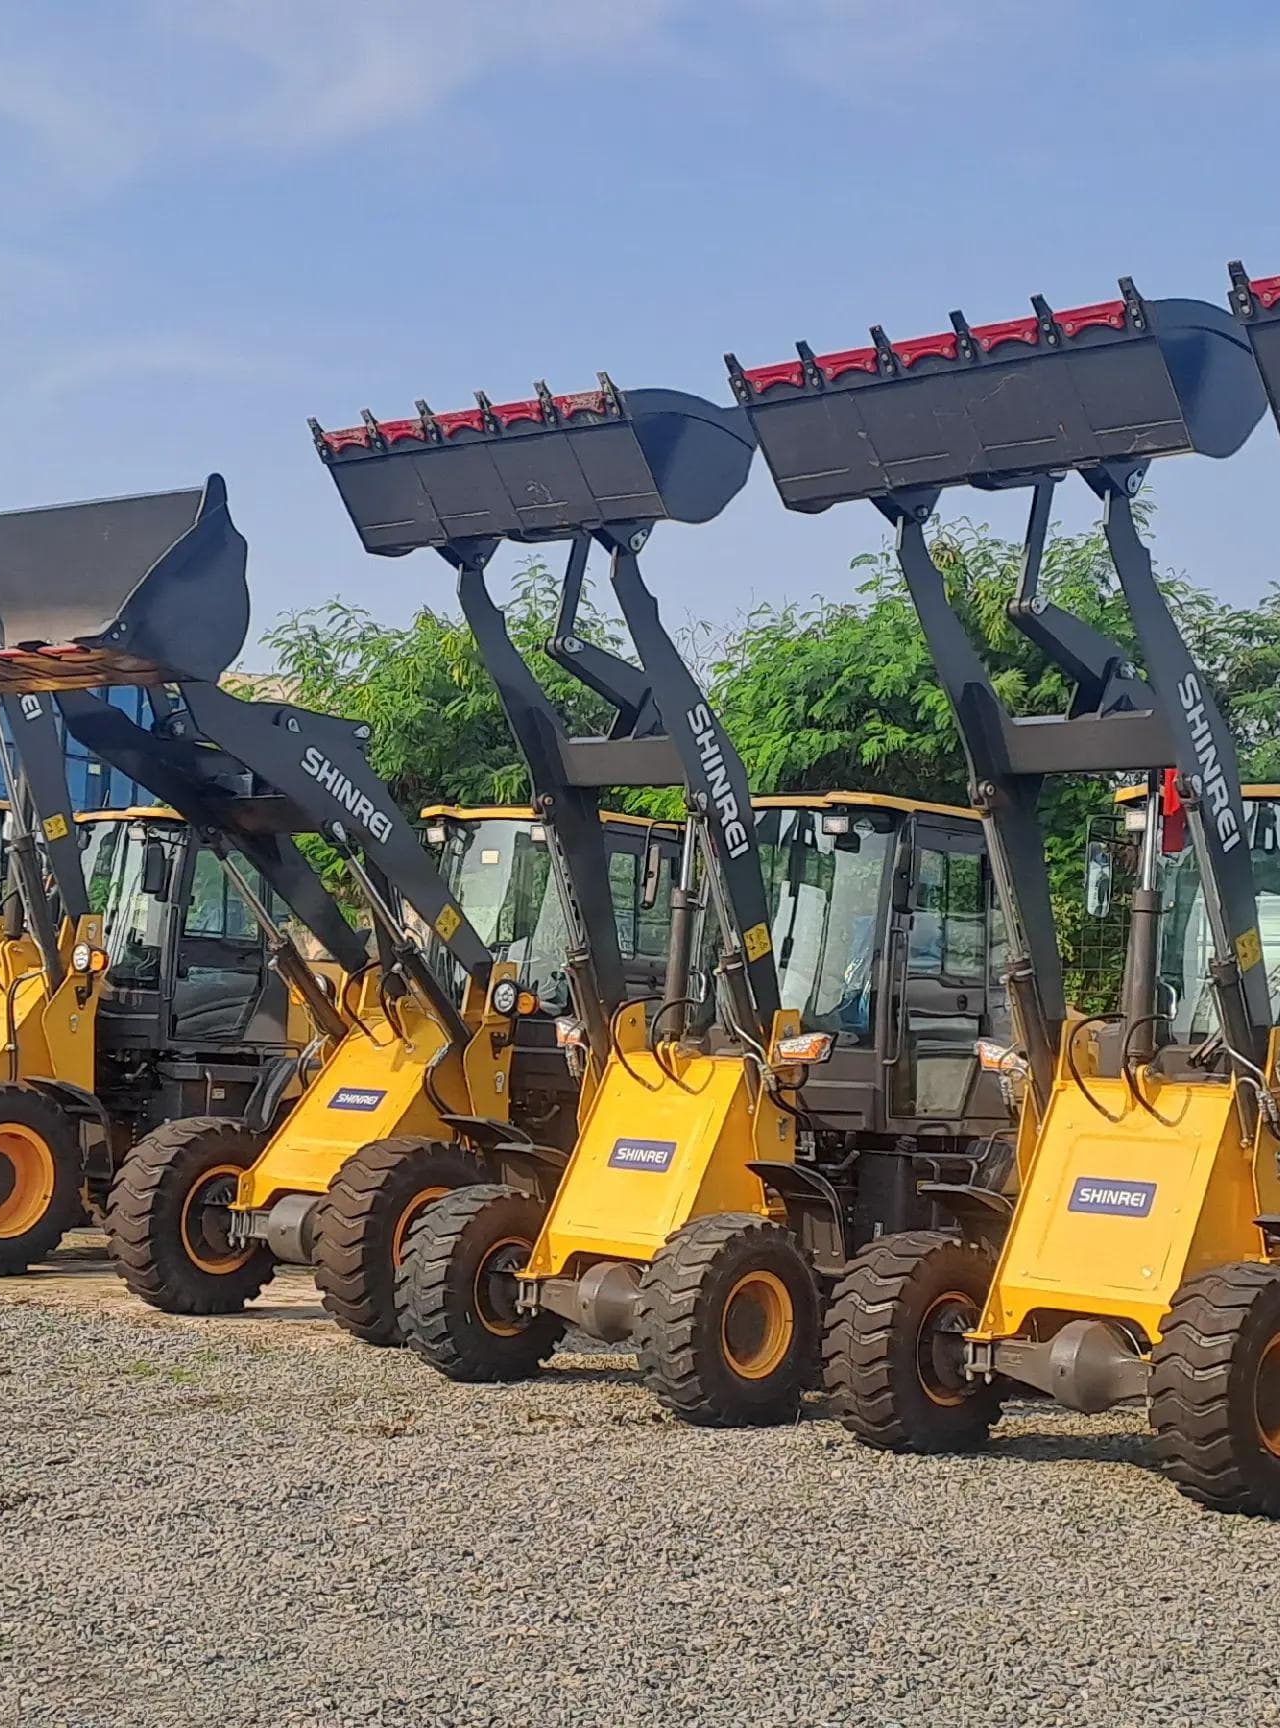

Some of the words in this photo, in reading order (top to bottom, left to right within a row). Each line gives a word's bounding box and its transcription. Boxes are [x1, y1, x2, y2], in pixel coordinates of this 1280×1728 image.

[301, 747, 393, 844] SHINREI
[687, 703, 749, 859] SHINREI
[1177, 673, 1241, 853] SHINREI
[615, 1147, 668, 1165] SHINREI
[1078, 1188, 1147, 1208] SHINREI
